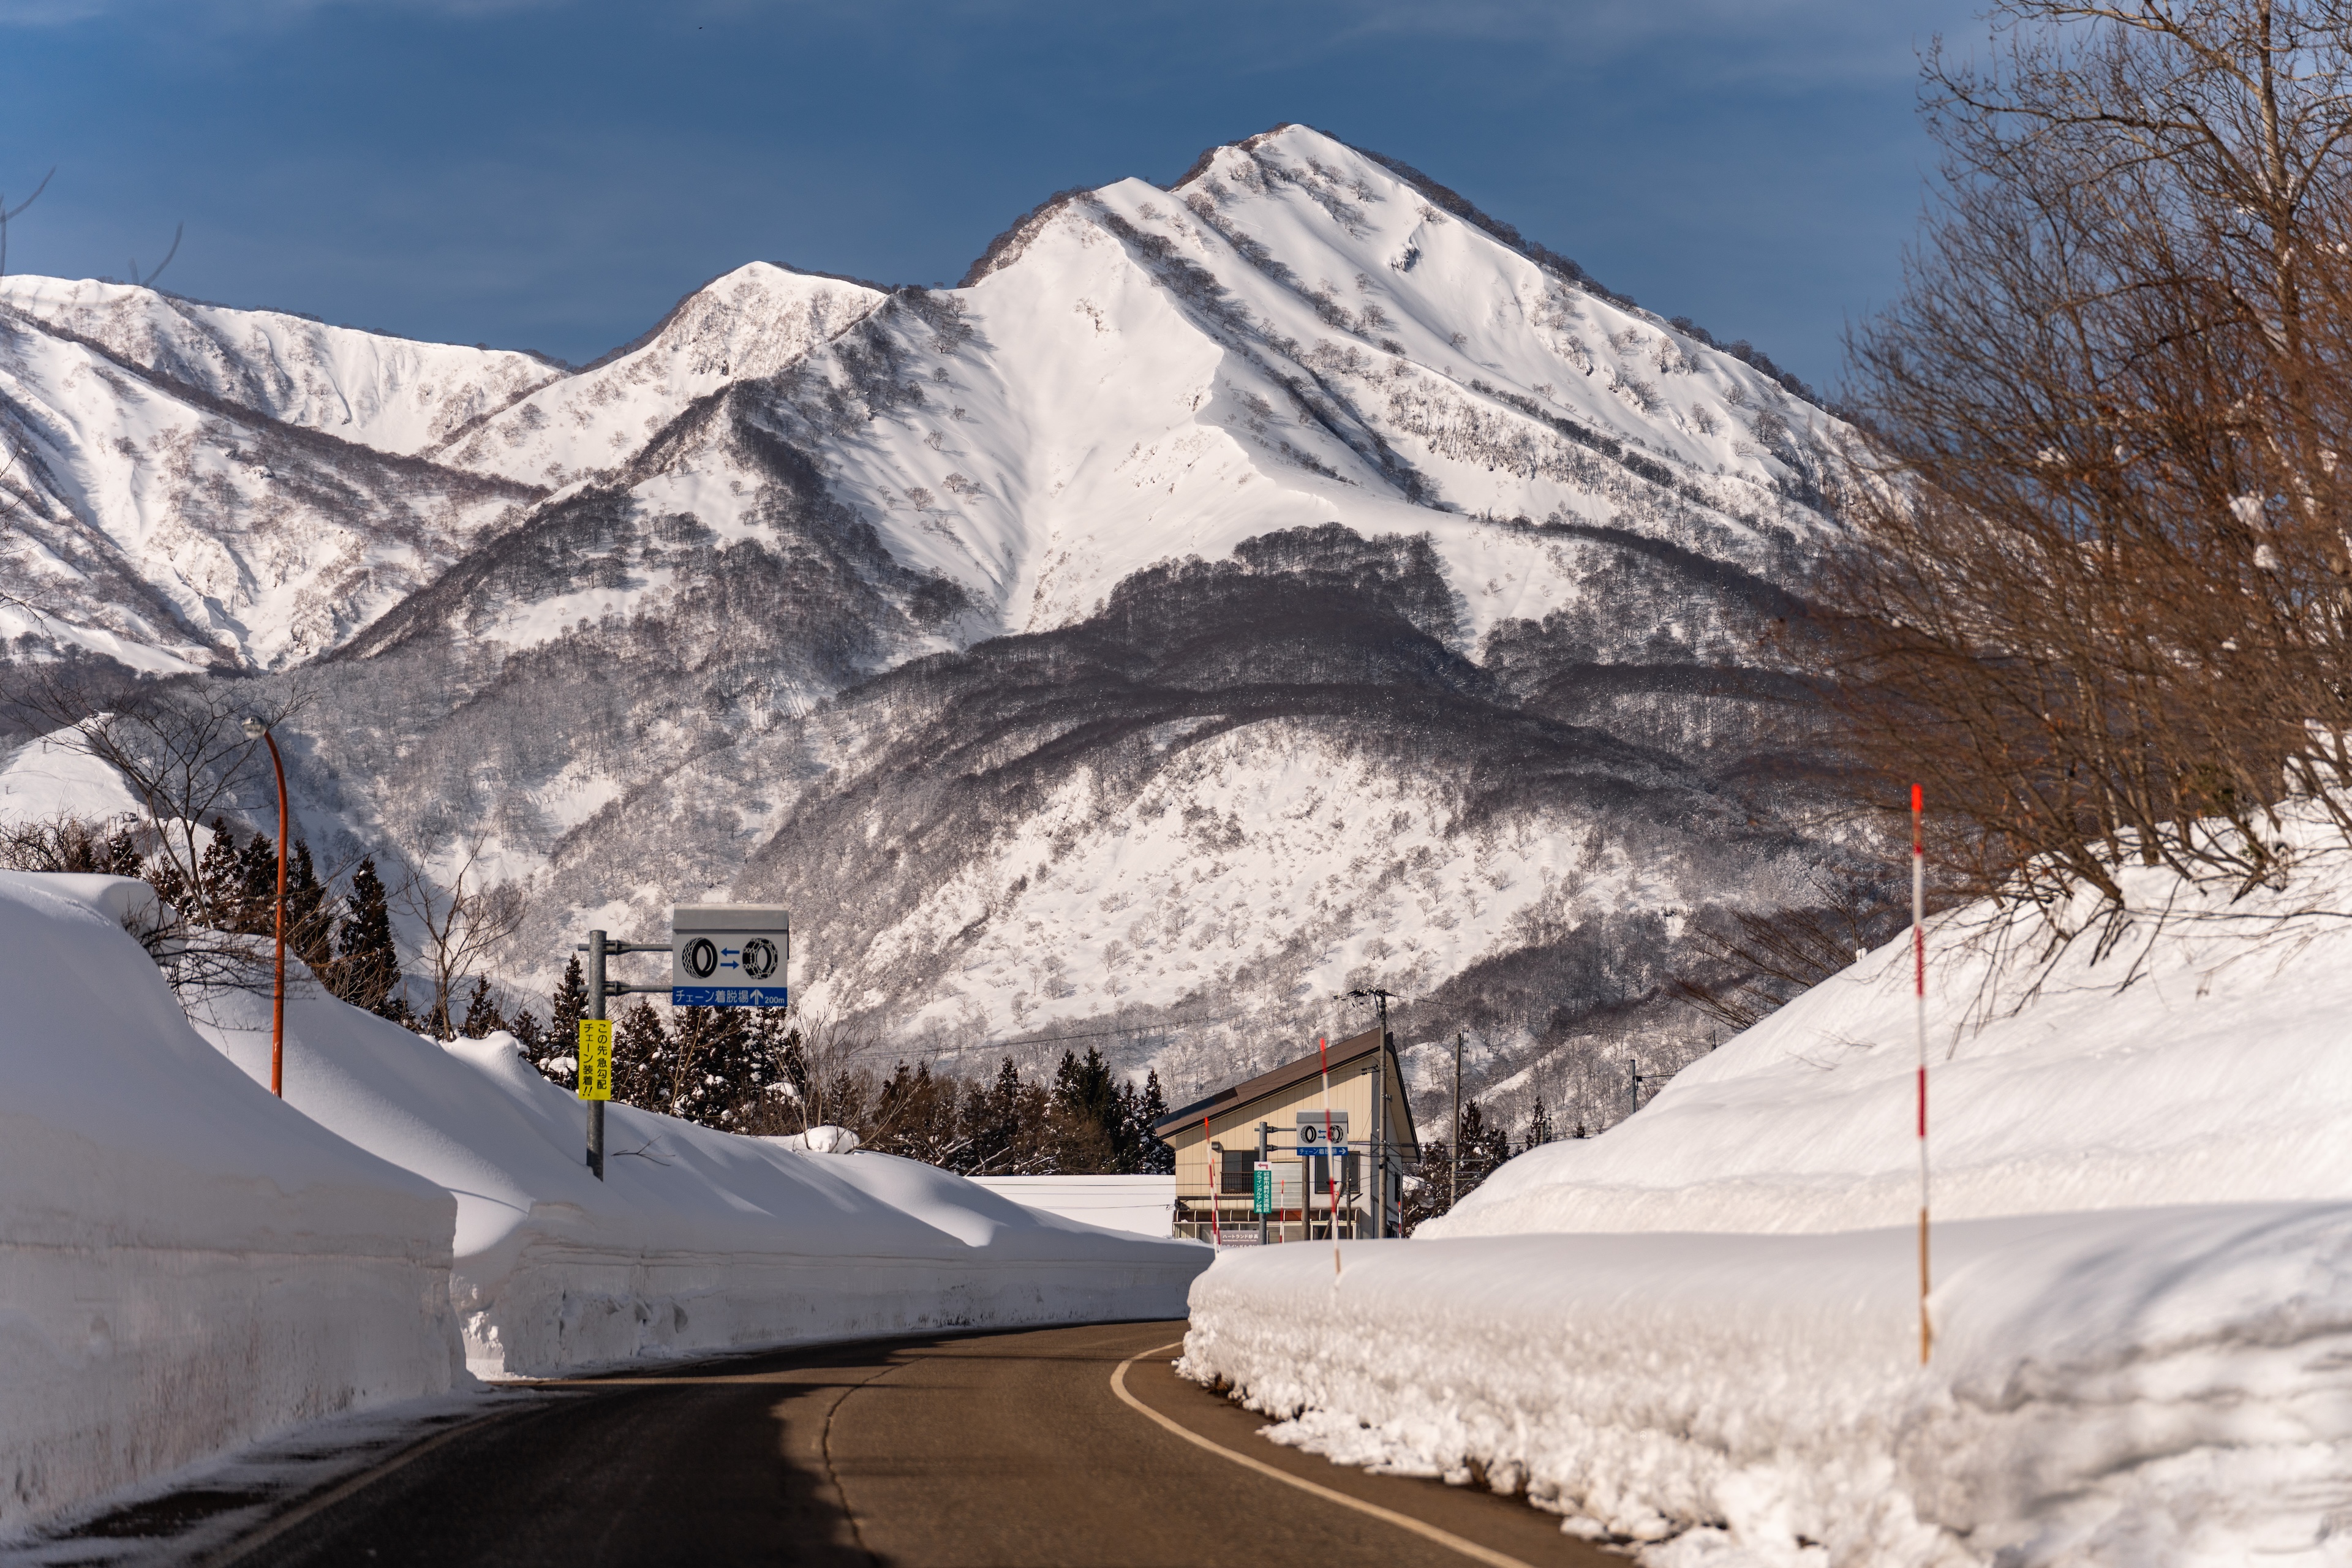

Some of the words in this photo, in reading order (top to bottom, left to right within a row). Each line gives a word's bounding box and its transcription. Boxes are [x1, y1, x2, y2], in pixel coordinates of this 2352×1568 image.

[676, 989, 749, 1003] チェーン着脱場
[582, 1023, 594, 1096] チェーン装着!!
